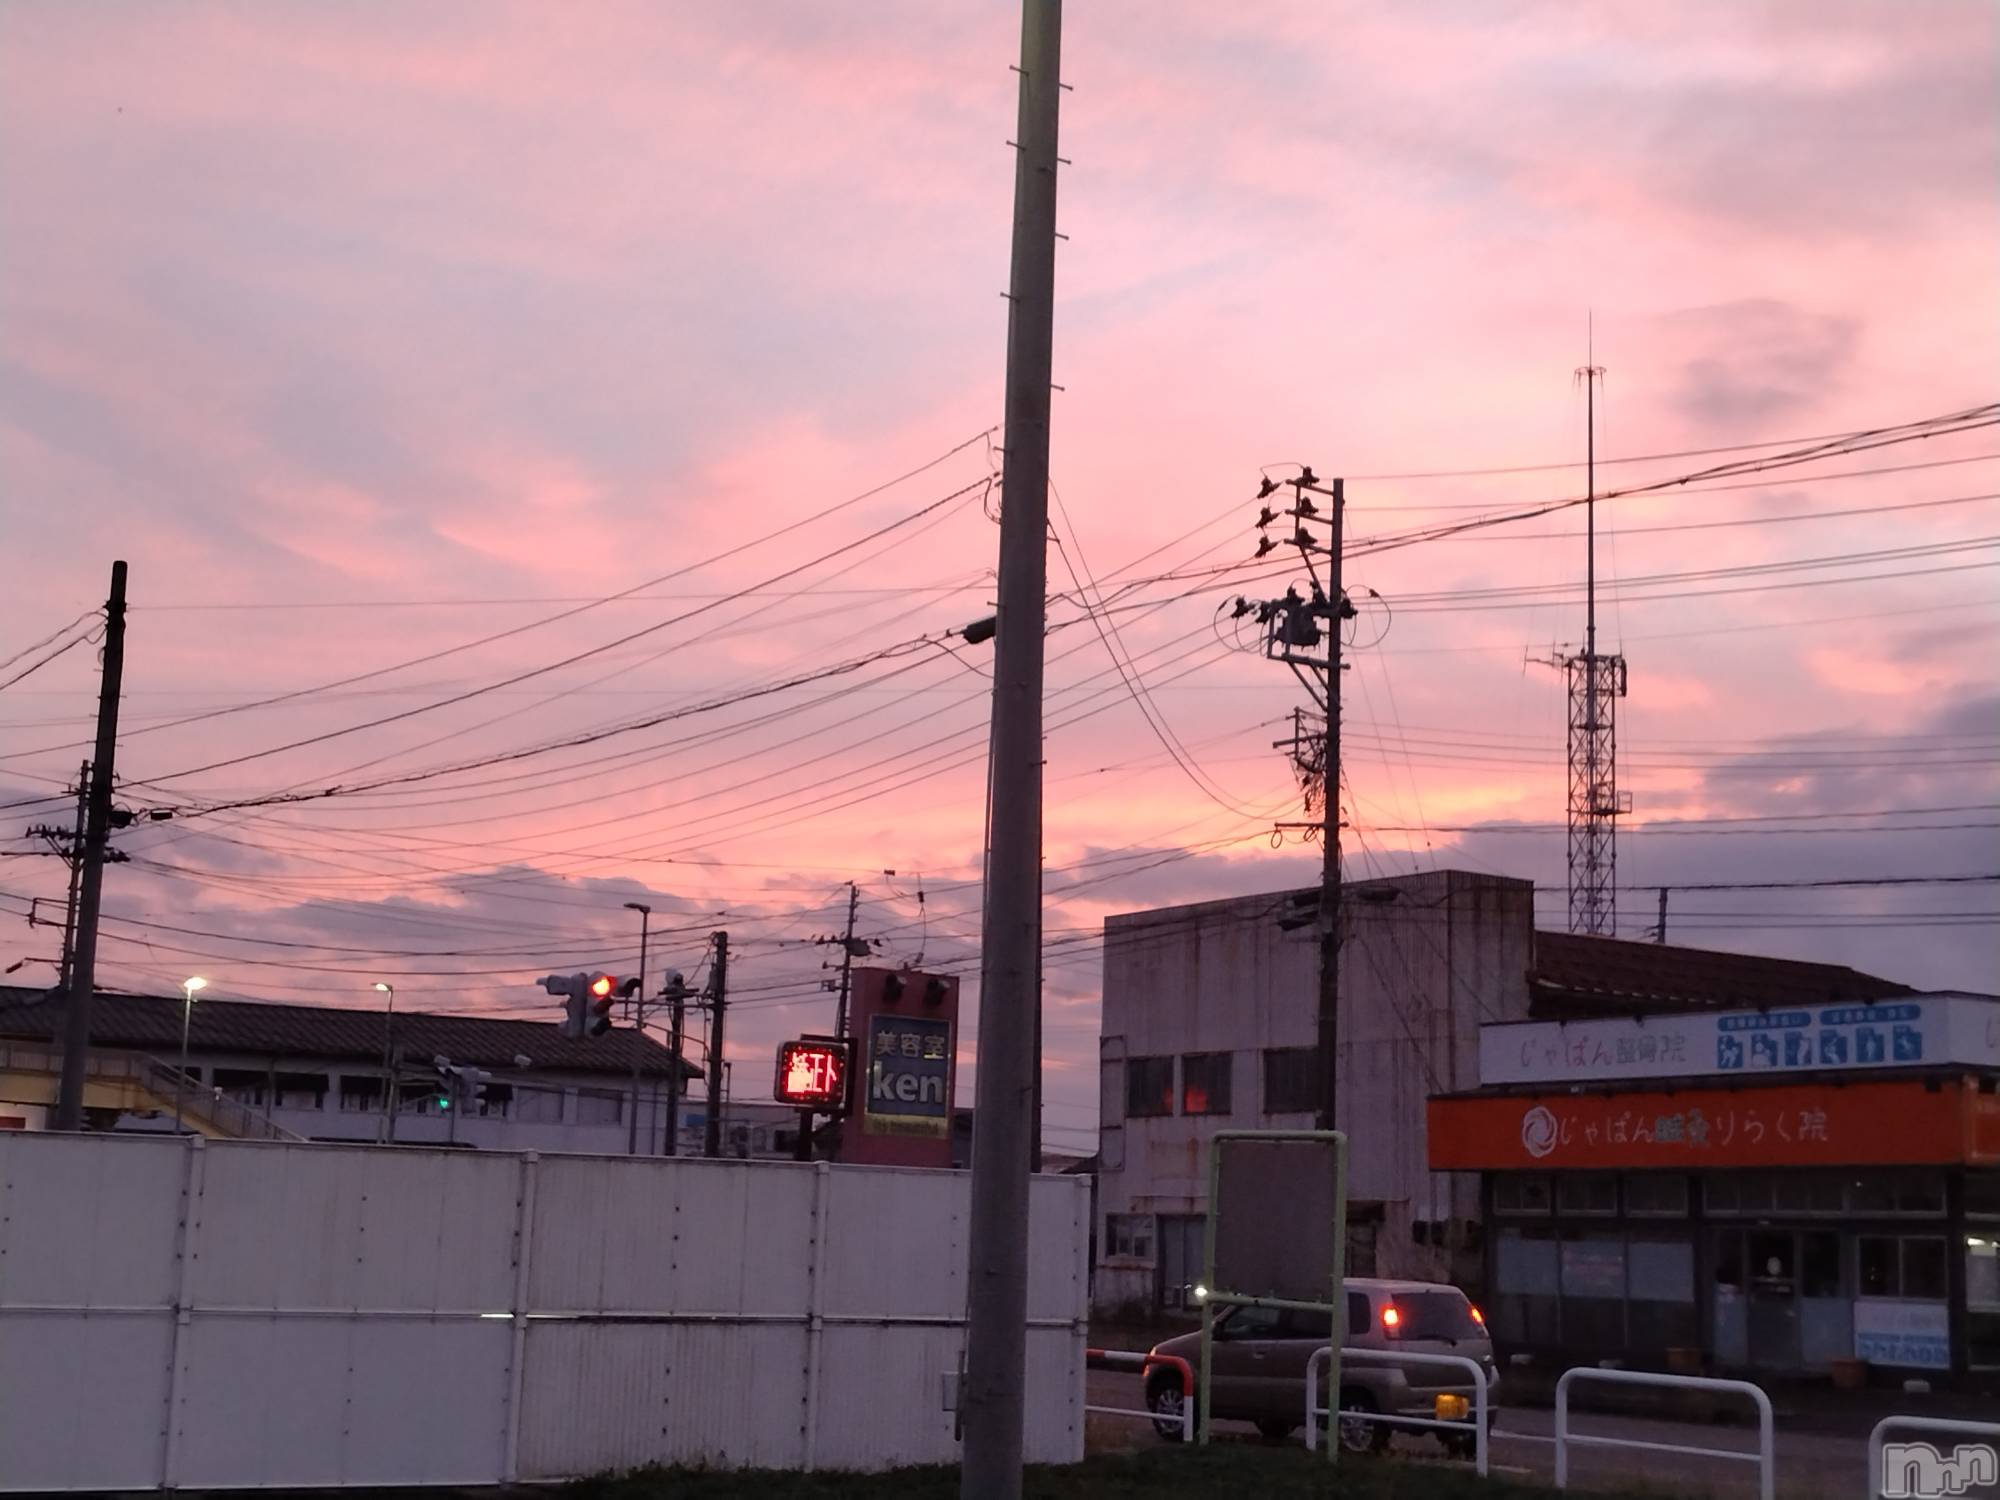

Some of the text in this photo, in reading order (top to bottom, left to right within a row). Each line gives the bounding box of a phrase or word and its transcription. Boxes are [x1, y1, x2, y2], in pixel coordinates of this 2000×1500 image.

[876, 1030, 945, 1059] 美容室
[872, 1060, 944, 1104] ken
